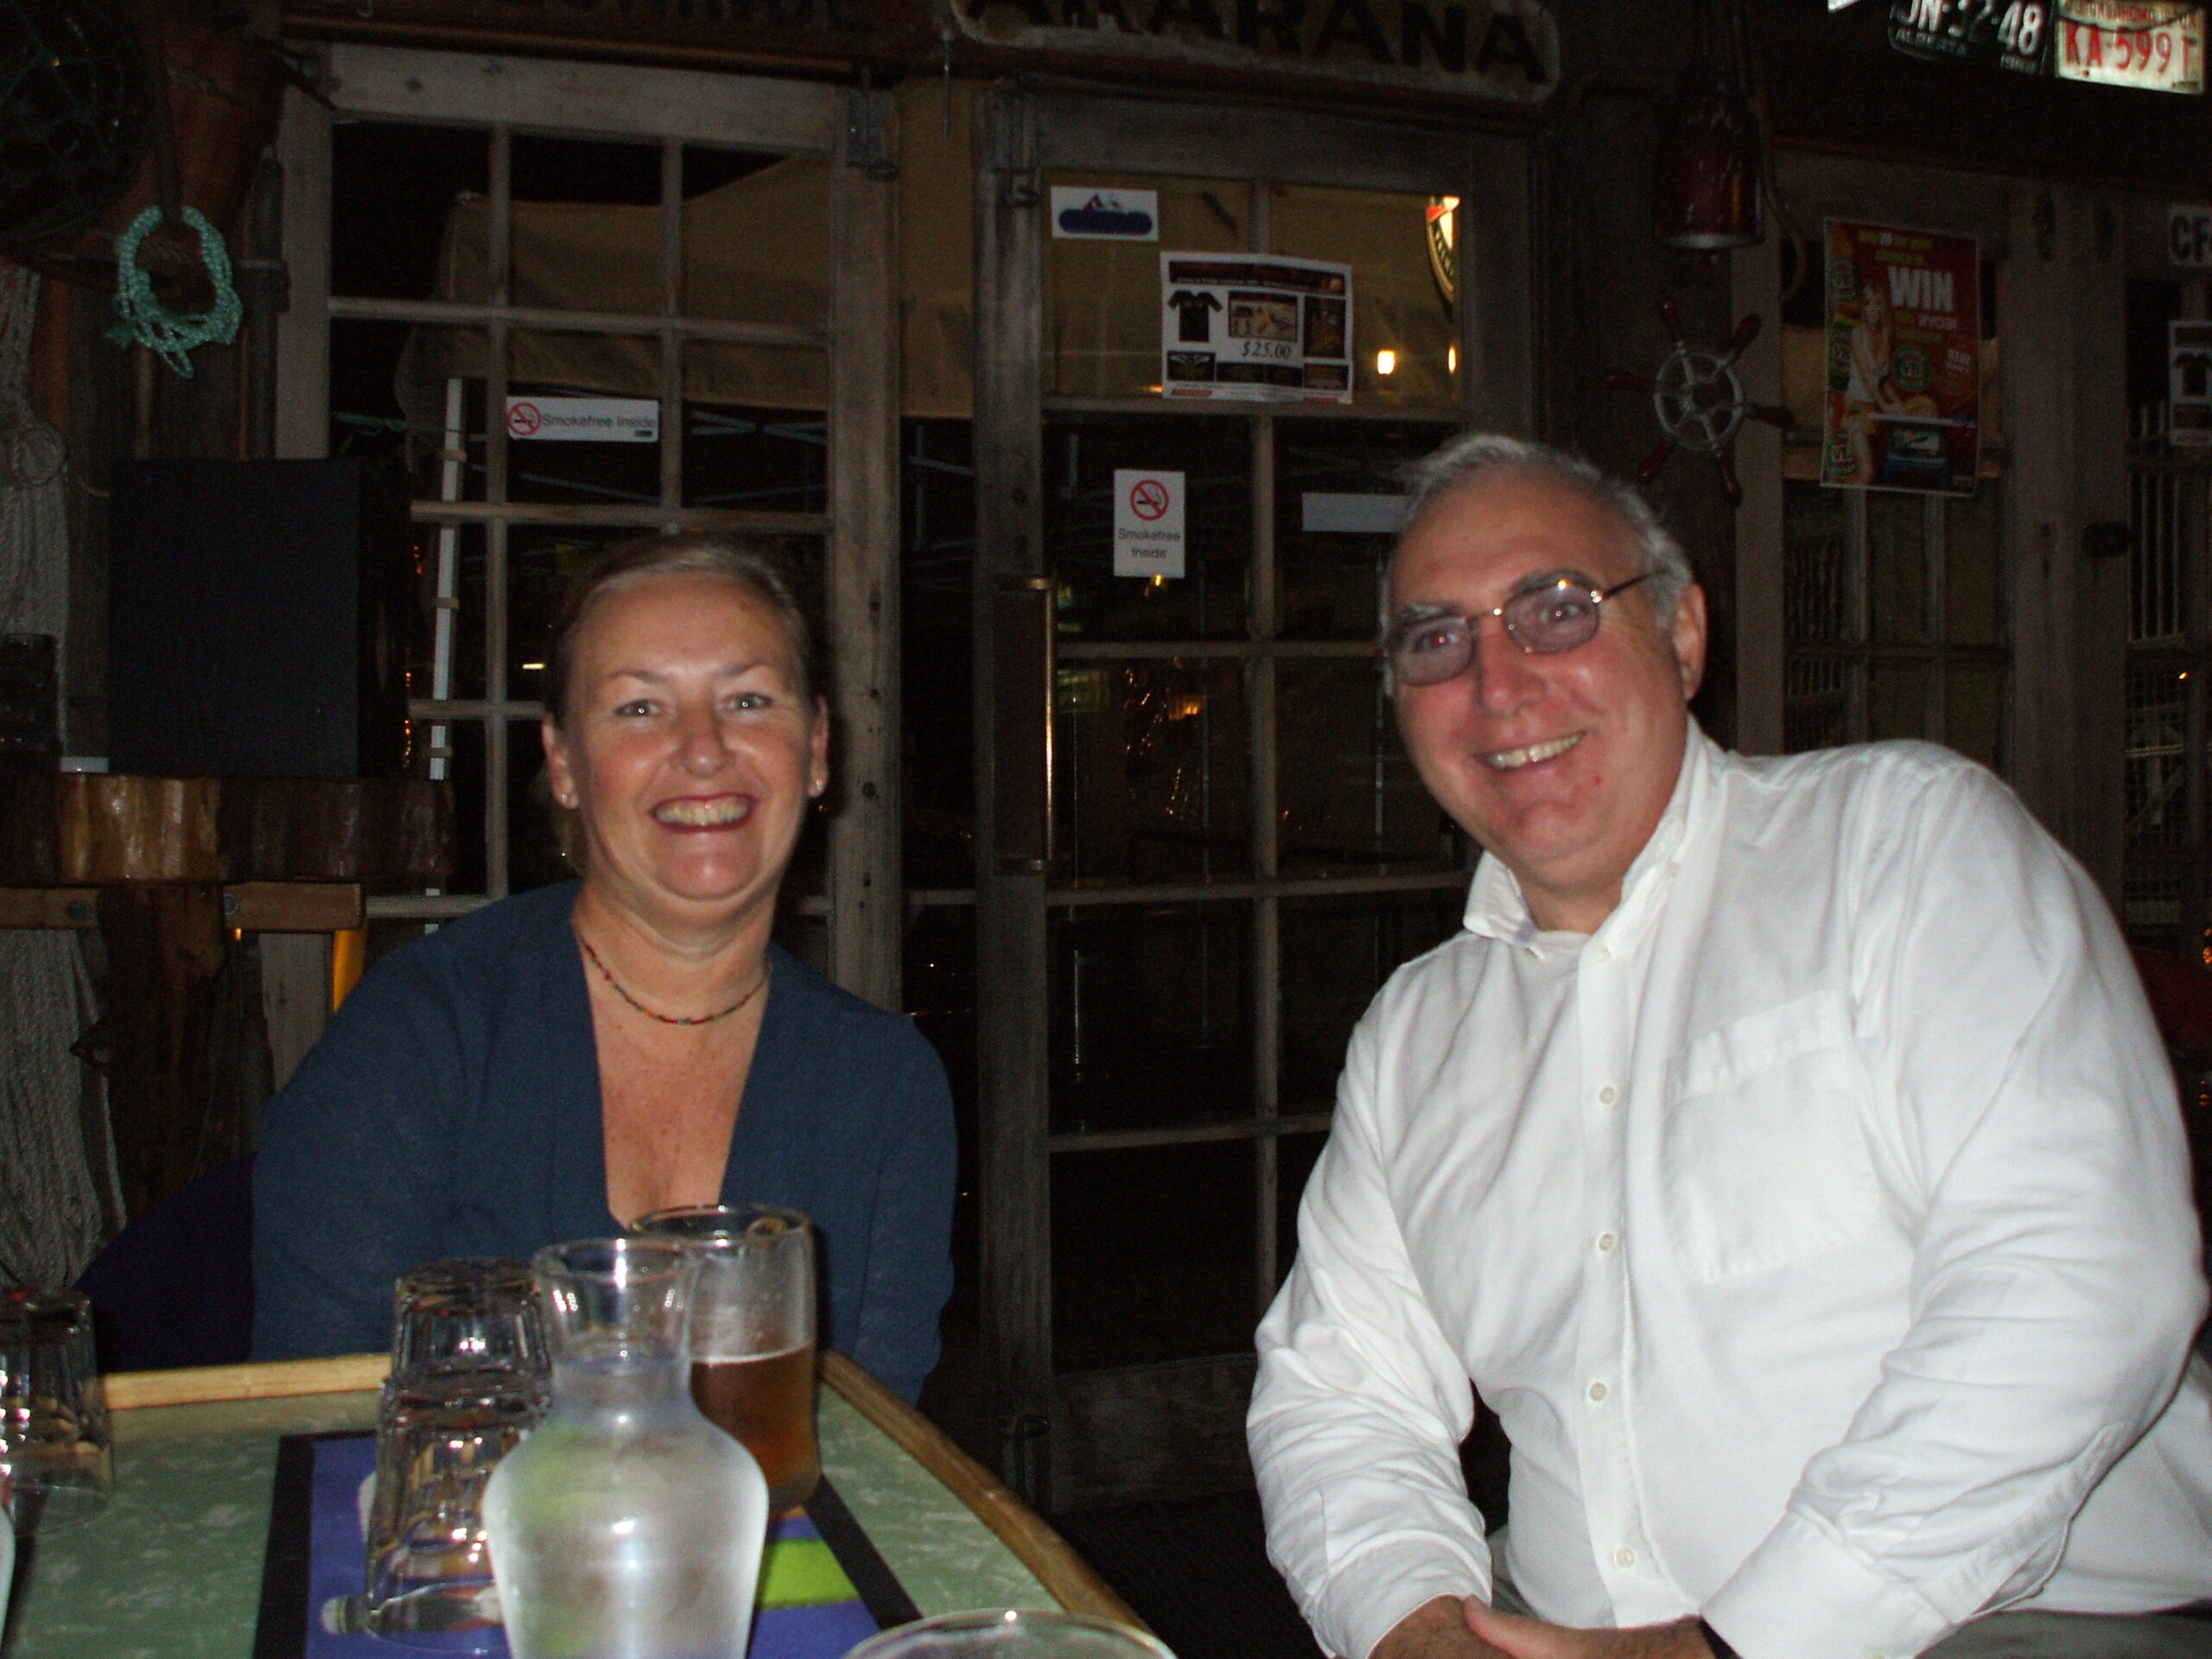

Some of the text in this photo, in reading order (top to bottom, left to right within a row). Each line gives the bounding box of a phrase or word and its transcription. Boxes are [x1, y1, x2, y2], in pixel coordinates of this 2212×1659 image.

[1887, 265, 1954, 312] WIN
[1242, 341, 1292, 360] $25.00
[543, 413, 613, 429] Smokefree
[1117, 527, 1180, 542] Smokefree
[1131, 547, 1166, 559] Inside
